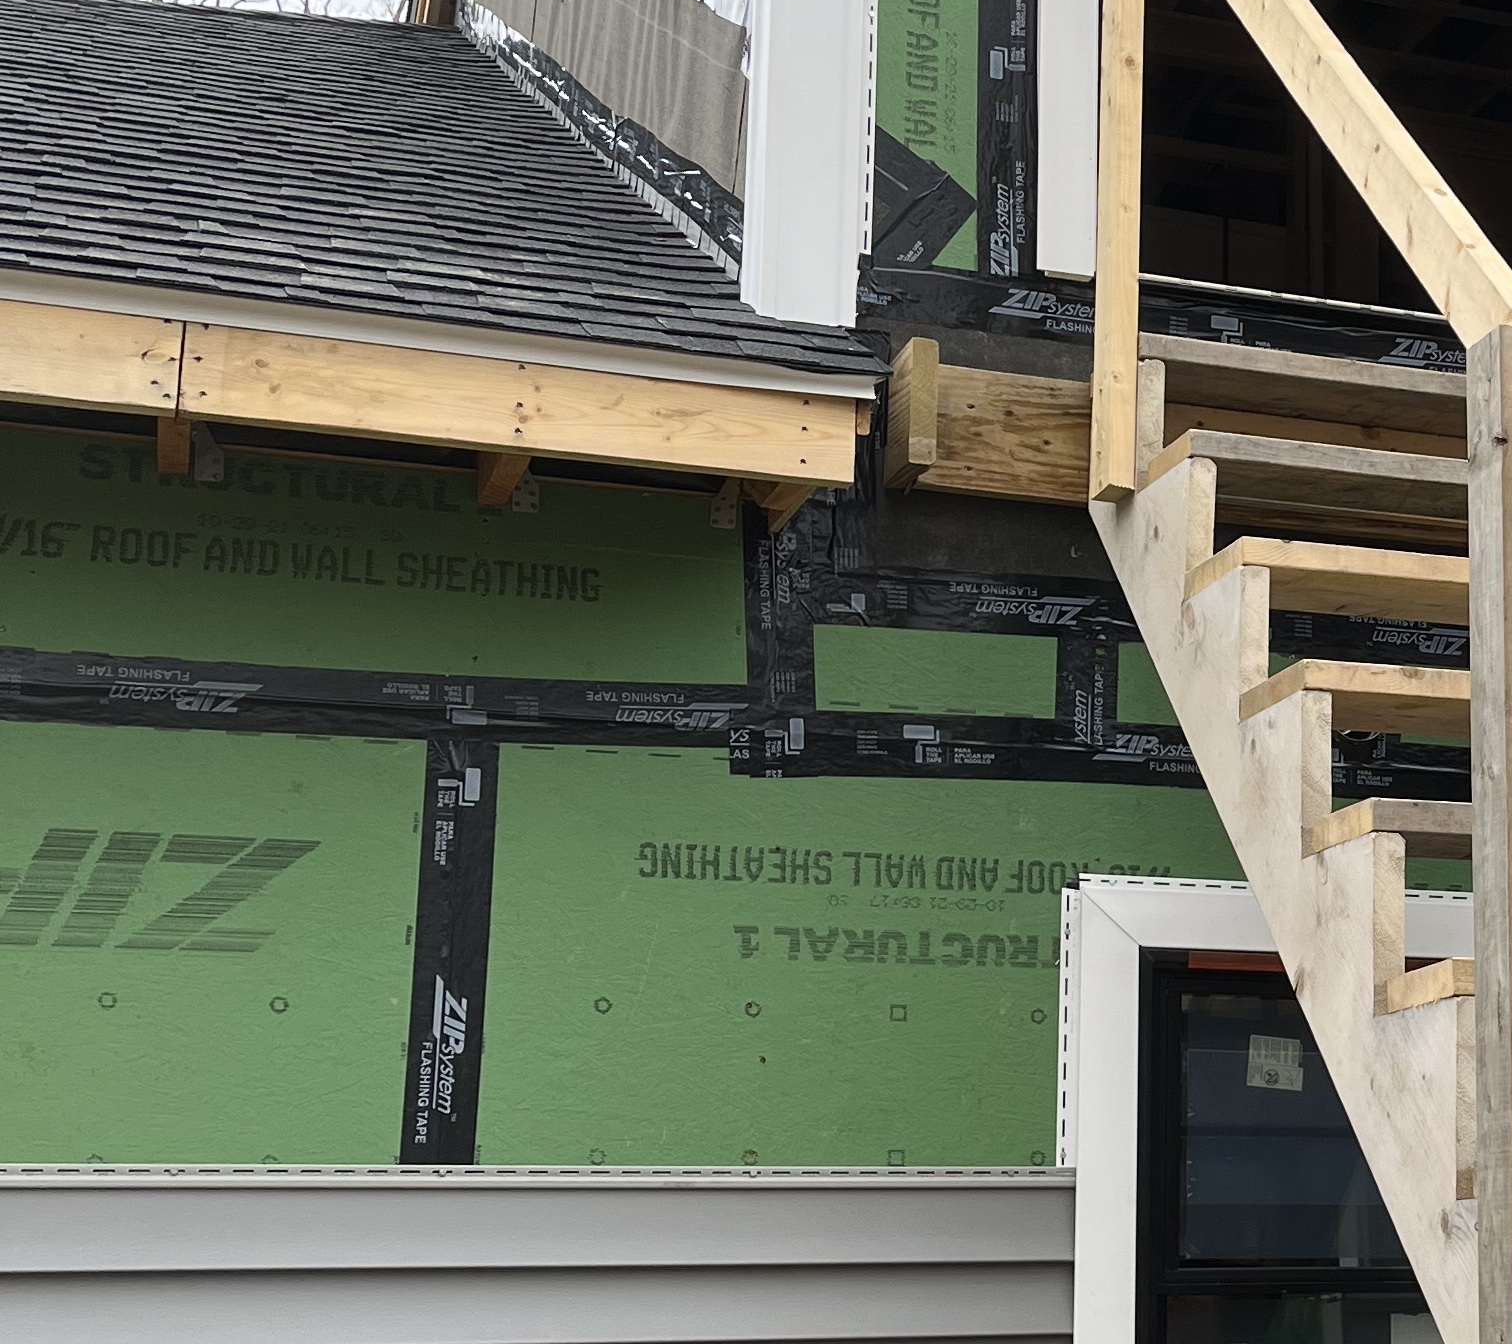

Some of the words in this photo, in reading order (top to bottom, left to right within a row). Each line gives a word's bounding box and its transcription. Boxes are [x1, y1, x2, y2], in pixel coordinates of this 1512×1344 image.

[906, 30, 939, 92] AND
[904, 96, 938, 152] WAL
[1015, 160, 1026, 190] TAPE
[990, 182, 1009, 277] ZIPsystem
[1015, 191, 1027, 245] FLASHING
[1000, 288, 1096, 319] ZIPsyste
[1046, 318, 1096, 335] FLASHIN
[1389, 337, 1467, 366] ZIPsyste
[90, 523, 199, 570] ROOF
[203, 536, 281, 578] AND
[291, 541, 388, 588] WALL
[395, 550, 606, 605] SHEATHING
[758, 539, 771, 599] FLASHING
[949, 581, 979, 594] TAPE
[980, 584, 1039, 598] FLASHING
[760, 599, 772, 631] TAPE
[975, 599, 1084, 627] ZIPsystem
[1372, 629, 1468, 656] ZIPsystem
[75, 663, 115, 679] TAPE
[117, 665, 191, 683] FLASHING
[108, 683, 248, 714] ZIPsystem
[585, 689, 619, 703] TAPE
[621, 691, 686, 705] FLASHING
[614, 707, 732, 732] ZIPsystem
[1074, 689, 1088, 745] ystem
[1093, 696, 1105, 746] LASHING
[1115, 733, 1195, 758] ZIPsyste
[636, 840, 833, 887] SHEATHING
[842, 850, 926, 889] WALL
[935, 855, 1000, 893] AND
[773, 926, 1061, 969] TRUCTURAL
[438, 989, 469, 1116] ZIPsystem
[417, 1040, 434, 1107] FLASHING
[414, 1110, 429, 1145] TAPE
